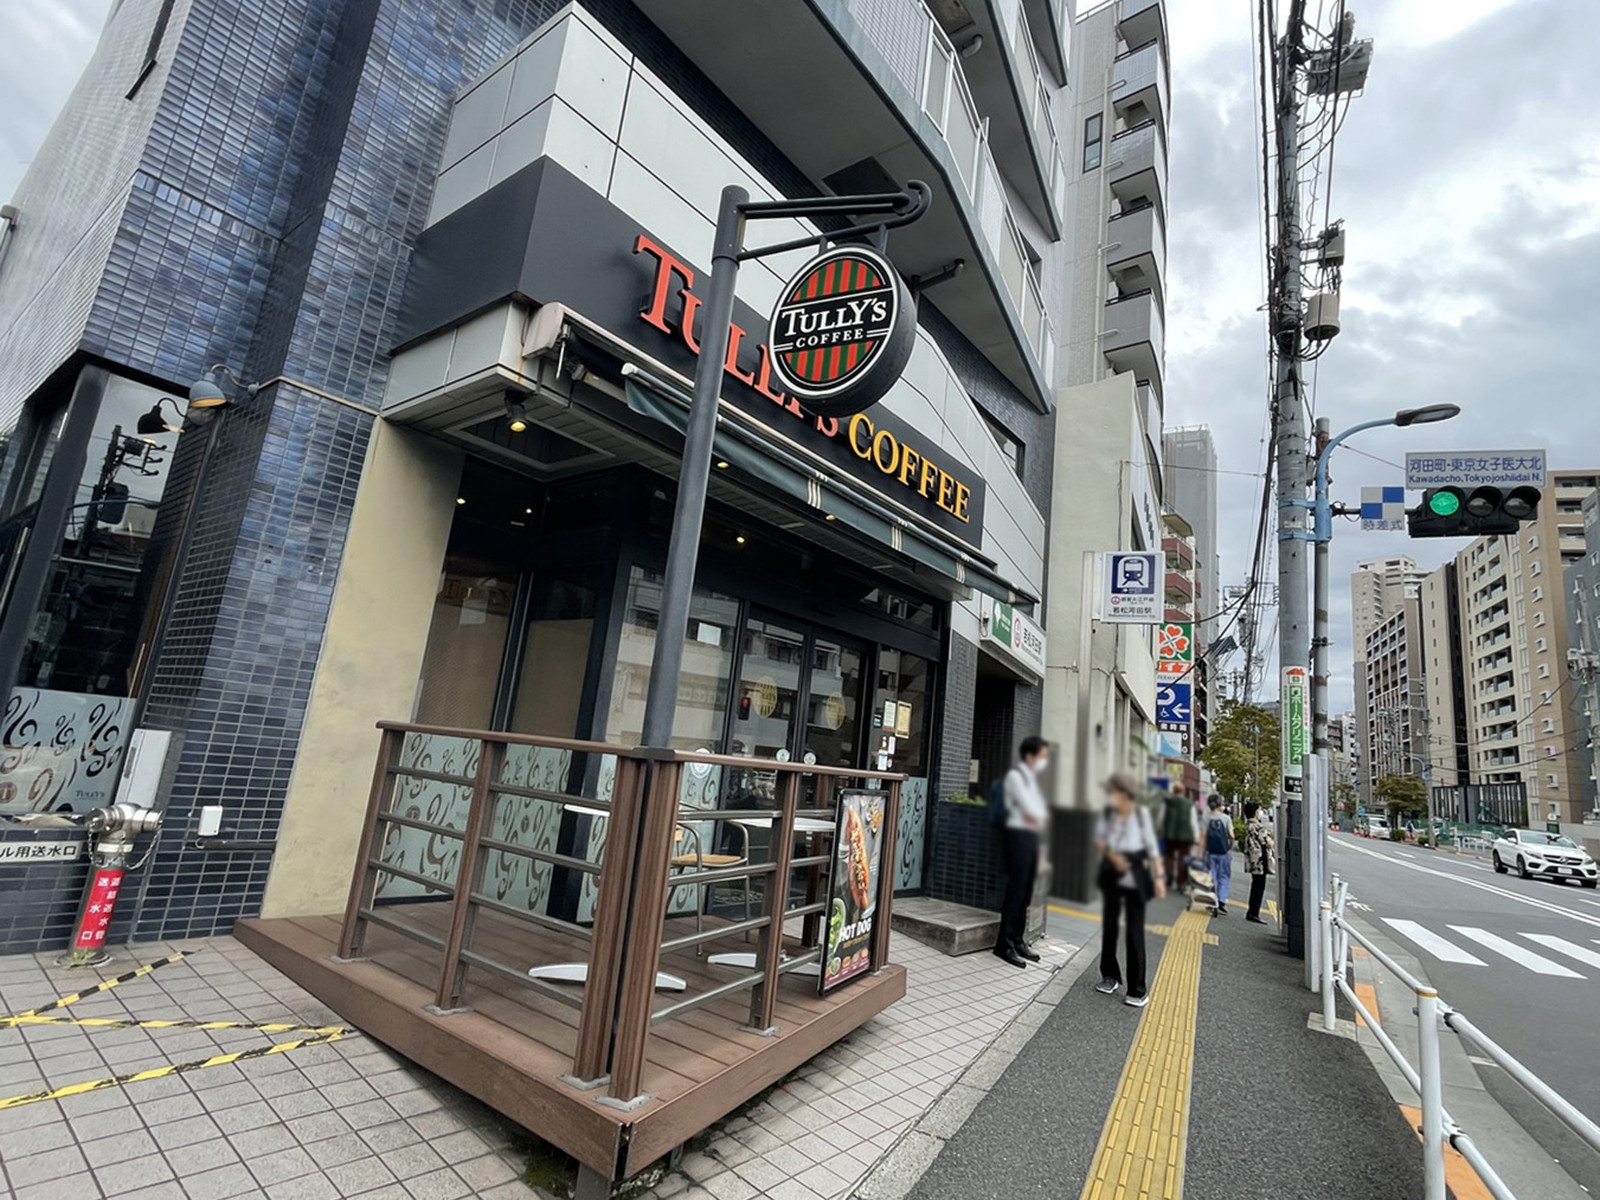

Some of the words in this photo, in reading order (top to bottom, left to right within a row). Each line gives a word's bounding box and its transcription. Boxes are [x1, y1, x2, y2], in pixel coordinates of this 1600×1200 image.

[781, 298, 887, 336] TULLY'S
[796, 328, 864, 348] COFFEE
[637, 234, 838, 437] TULL
[848, 413, 971, 524] COFFEE
[0, 845, 77, 858] ル用送水口
[81, 877, 109, 940] 送水口
[840, 922, 856, 941] HOT
[856, 917, 872, 936] DOG
